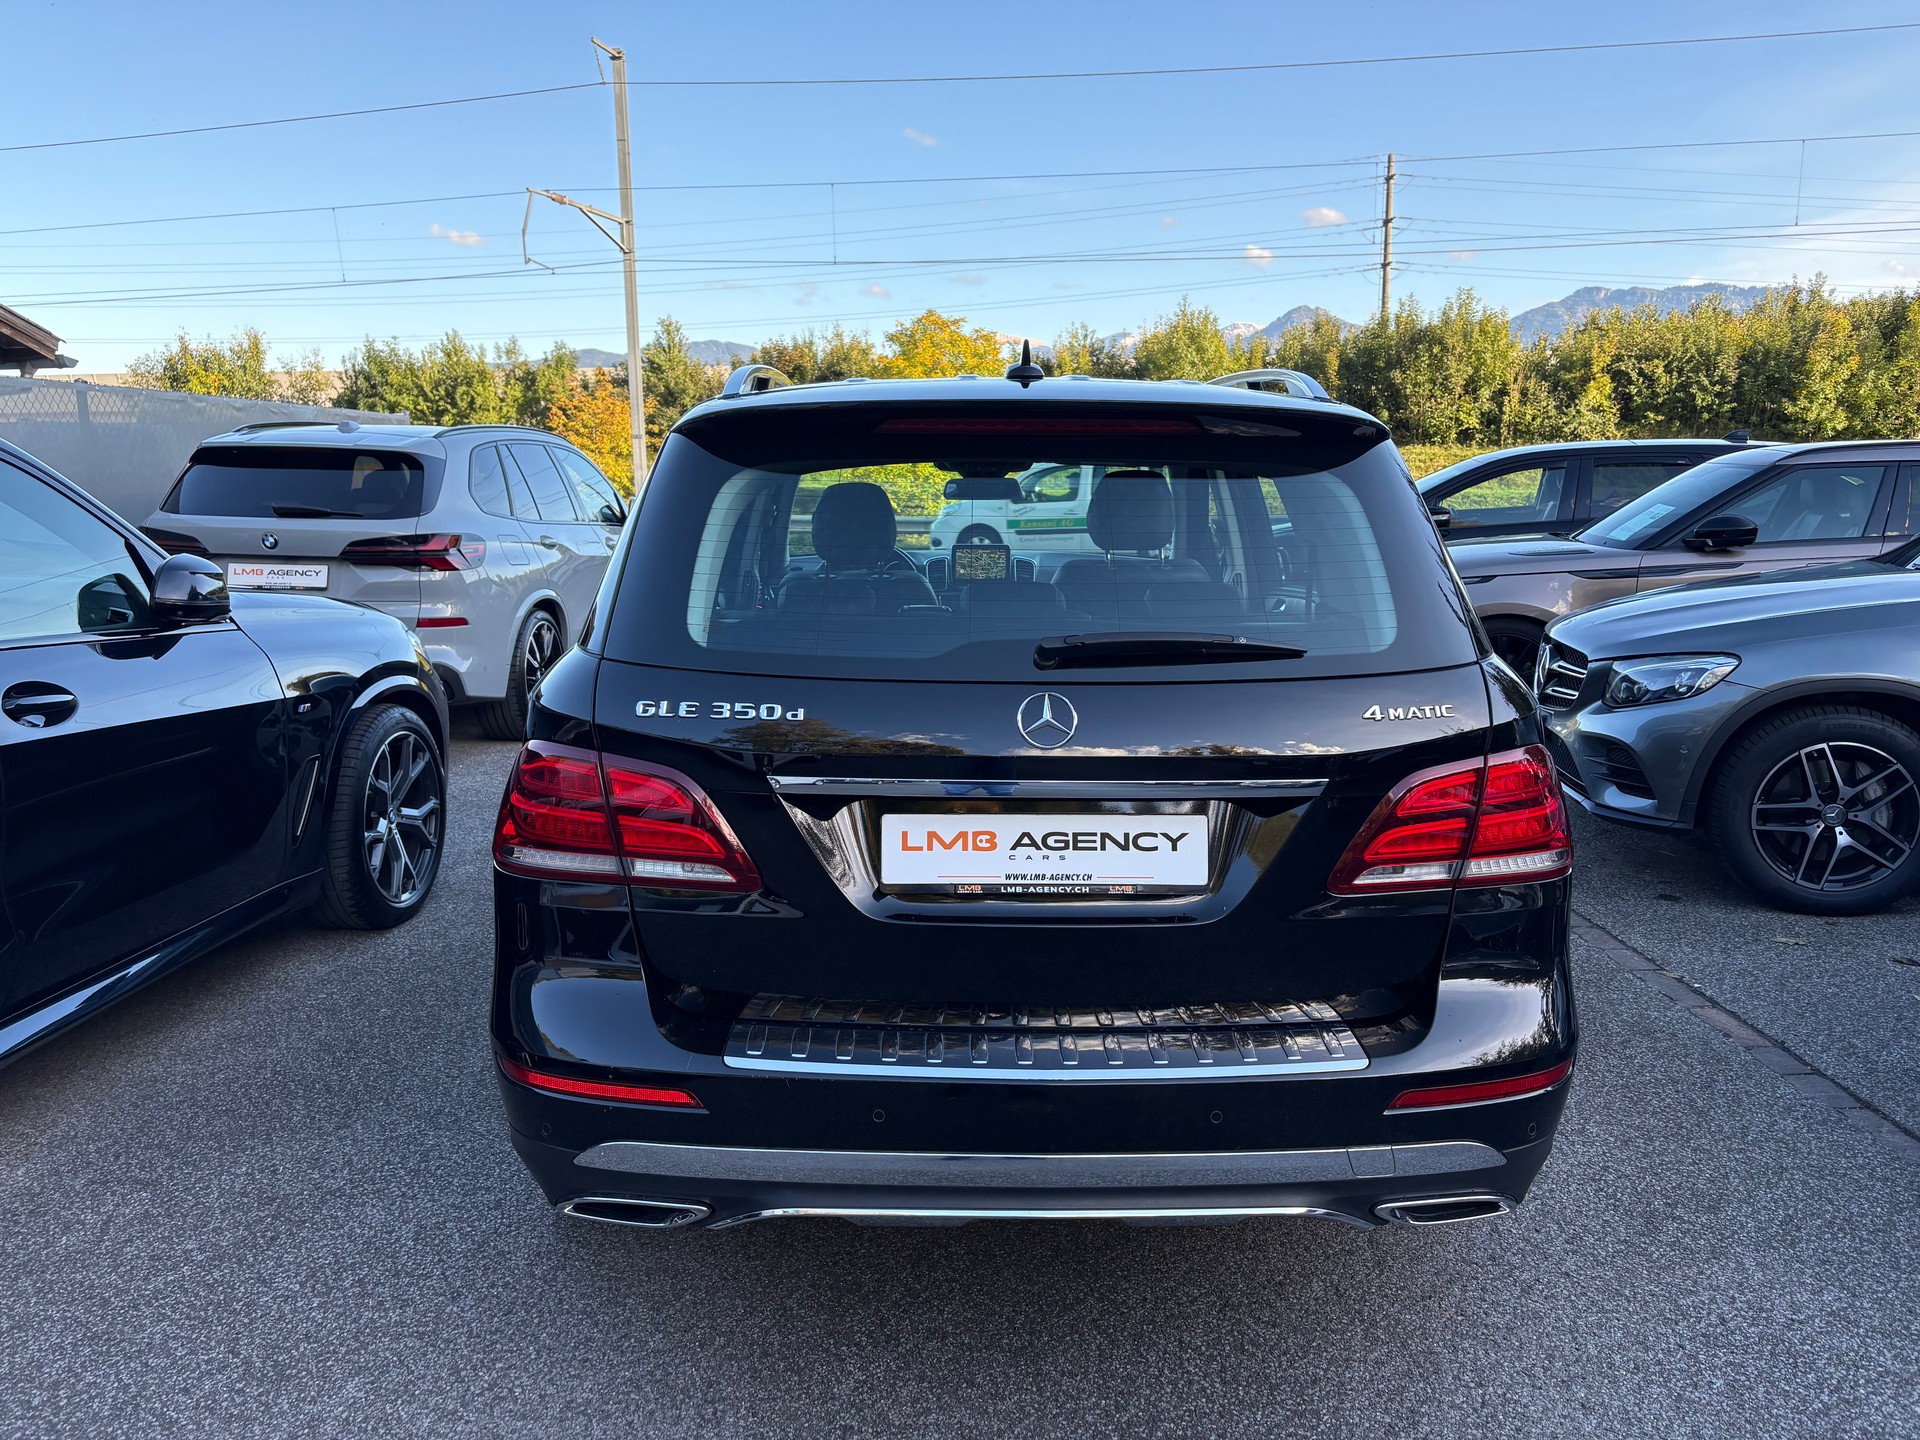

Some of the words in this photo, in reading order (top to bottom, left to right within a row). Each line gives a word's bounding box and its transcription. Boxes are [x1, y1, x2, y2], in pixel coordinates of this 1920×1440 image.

[1060, 519, 1073, 528] AG
[635, 700, 700, 719] GLE
[709, 701, 805, 721] 350d
[901, 830, 998, 852] LMB
[1009, 831, 1191, 852] AGENCY
[1004, 873, 1093, 882] WWW.LMB-AGENCY.CH
[1001, 885, 1090, 894] LMB-AGENCY.CH
